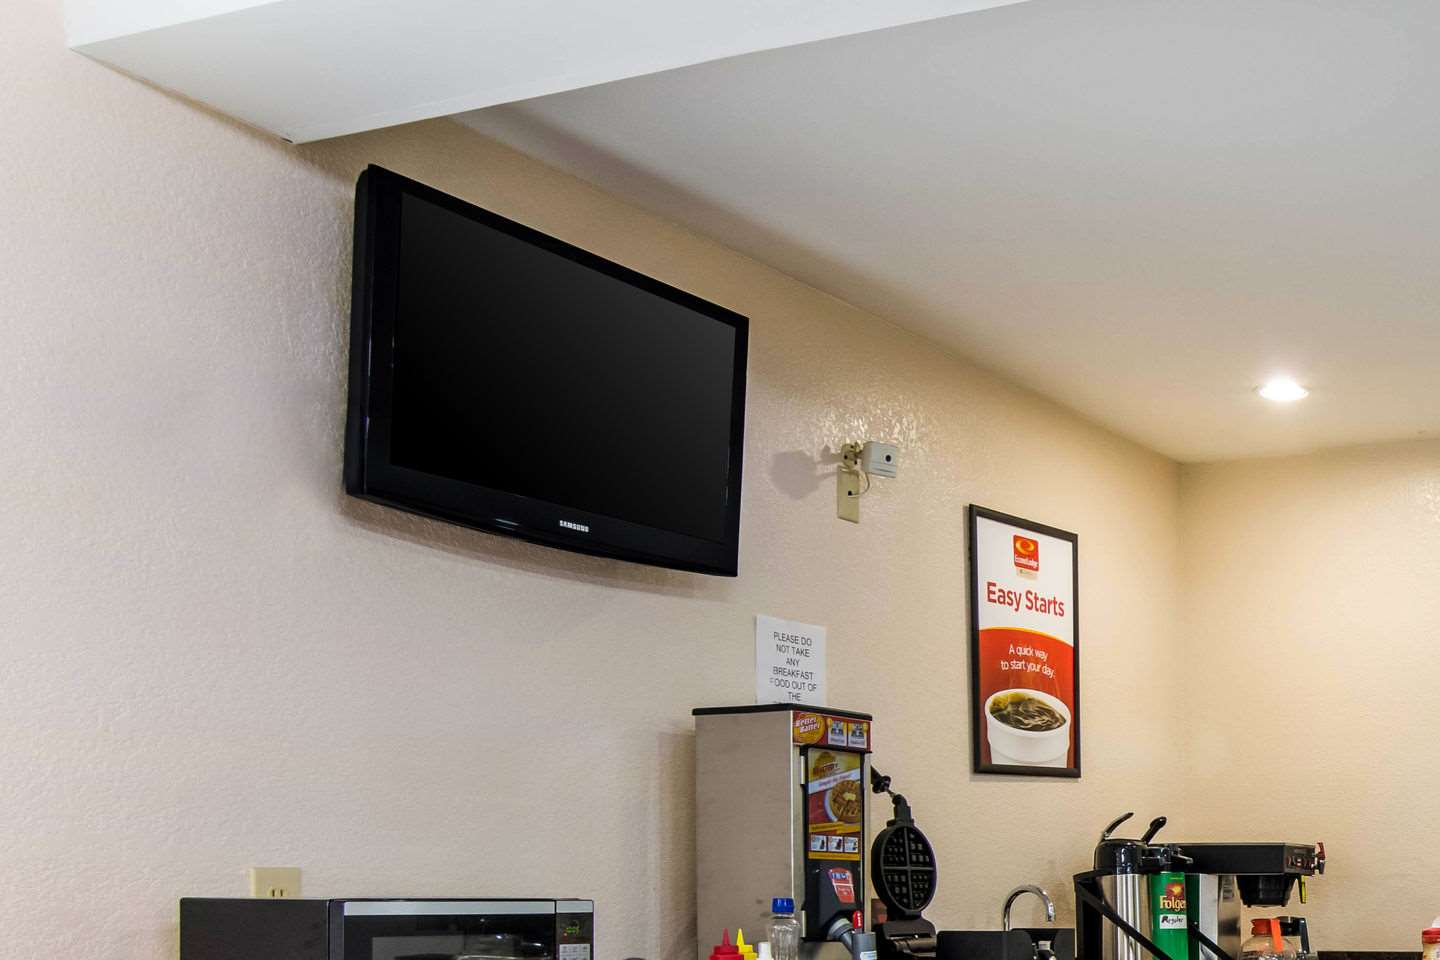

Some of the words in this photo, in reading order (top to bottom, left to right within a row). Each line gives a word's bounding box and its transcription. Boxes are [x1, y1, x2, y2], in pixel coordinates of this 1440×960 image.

[559, 520, 589, 532] SAMSUNG
[986, 581, 1022, 612] Easy
[1025, 590, 1065, 617] Starts
[773, 632, 799, 645] PLEASE
[801, 637, 812, 646] DO
[776, 644, 790, 654] NOT
[792, 646, 810, 657] TAKE
[1008, 643, 1015, 655] A
[1016, 645, 1034, 657] quick
[1035, 649, 1049, 662] way
[786, 657, 800, 667] ANY
[1000, 660, 1009, 670] to
[1010, 659, 1026, 670] start
[1026, 662, 1041, 673] your
[773, 666, 814, 681] BREAKFAST
[769, 677, 791, 689] FOOD
[791, 680, 806, 690] OUT
[807, 683, 817, 692] OF
[788, 691, 801, 702] THE
